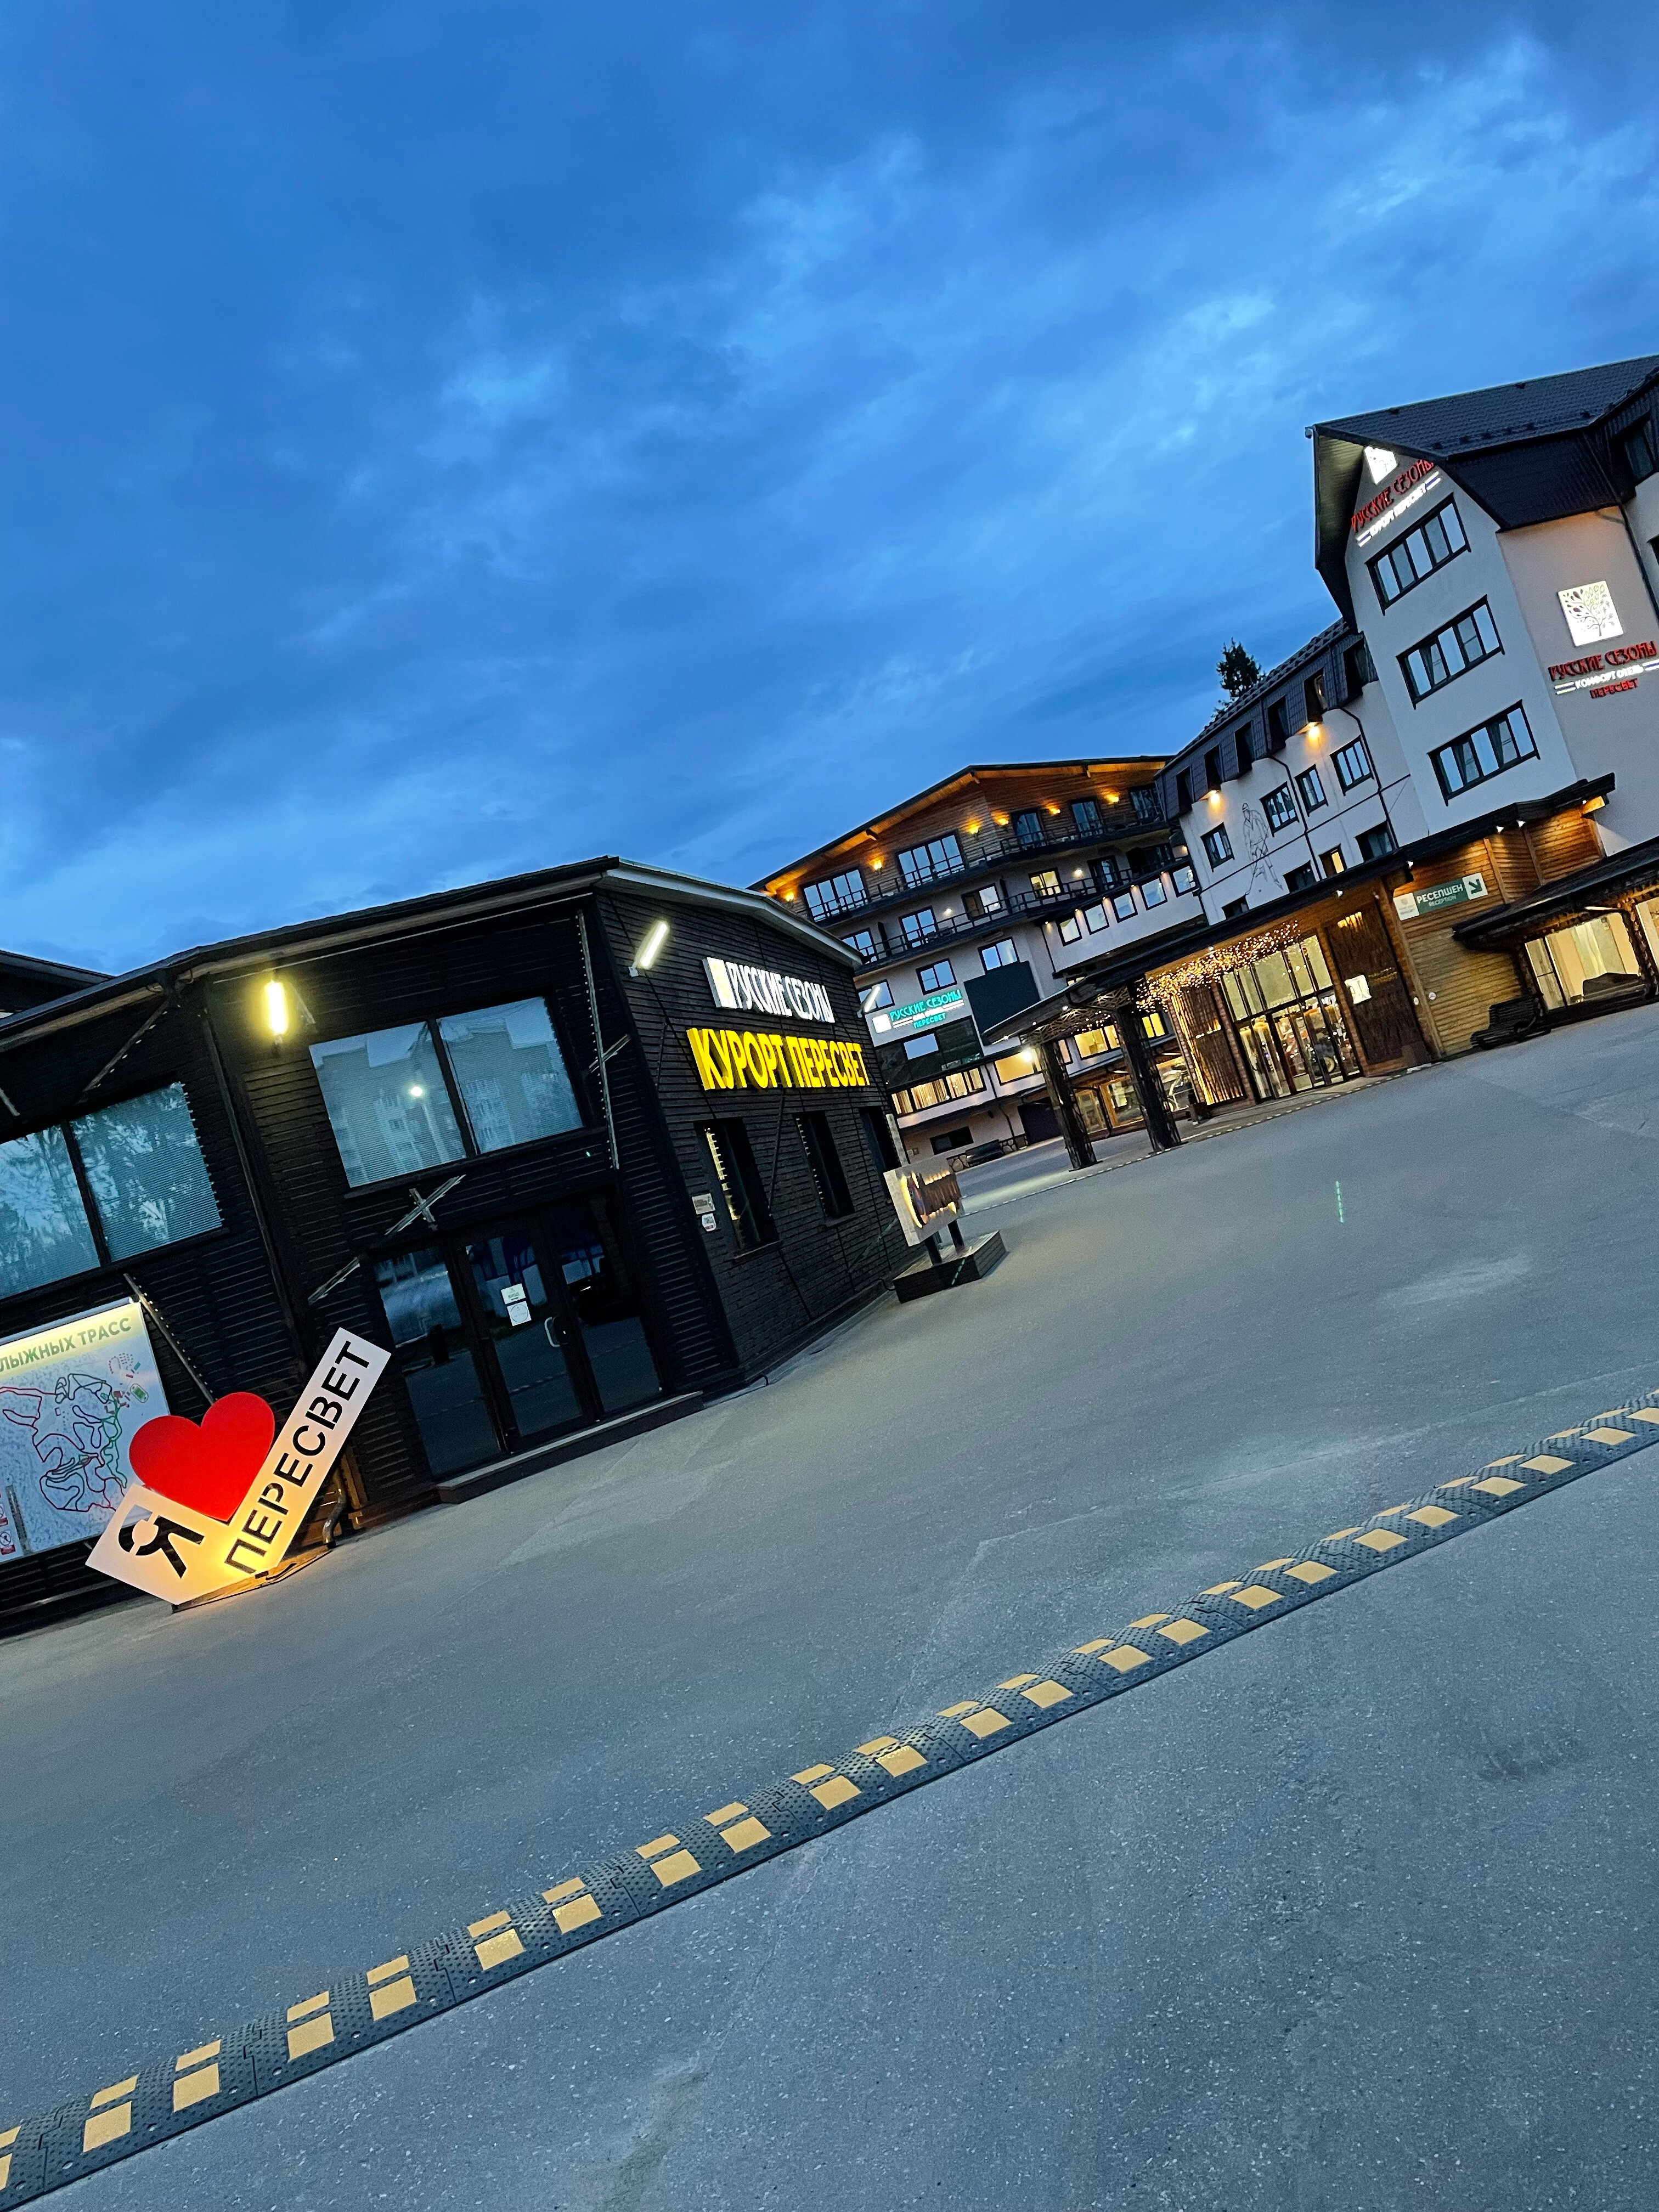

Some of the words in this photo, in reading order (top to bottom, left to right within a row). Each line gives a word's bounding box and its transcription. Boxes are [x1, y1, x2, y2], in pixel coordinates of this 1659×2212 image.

[1548, 654, 1605, 682] РУССКИЕ
[1605, 640, 1658, 665] СЕЗОНЫ
[1416, 883, 1464, 904] РЕСЕПШЕН
[725, 961, 793, 1017] РУССКИЕ
[785, 975, 836, 1023] СЕЗОНЫ
[889, 1001, 926, 1022] РУССКИЕ
[926, 989, 962, 1008] СЕЗОНЫ
[913, 1012, 946, 1029] ПЕРЕСВЕТ
[687, 1028, 792, 1090] КУРОРТ
[786, 1036, 870, 1088] ПЕРЕСВЕТ
[0, 1335, 76, 1372] ЛЫЖНЫХ
[77, 1318, 131, 1345] ТРАСС
[224, 1340, 370, 1575] ПЕРЕСВЕТ
[118, 1504, 205, 1579] Я
